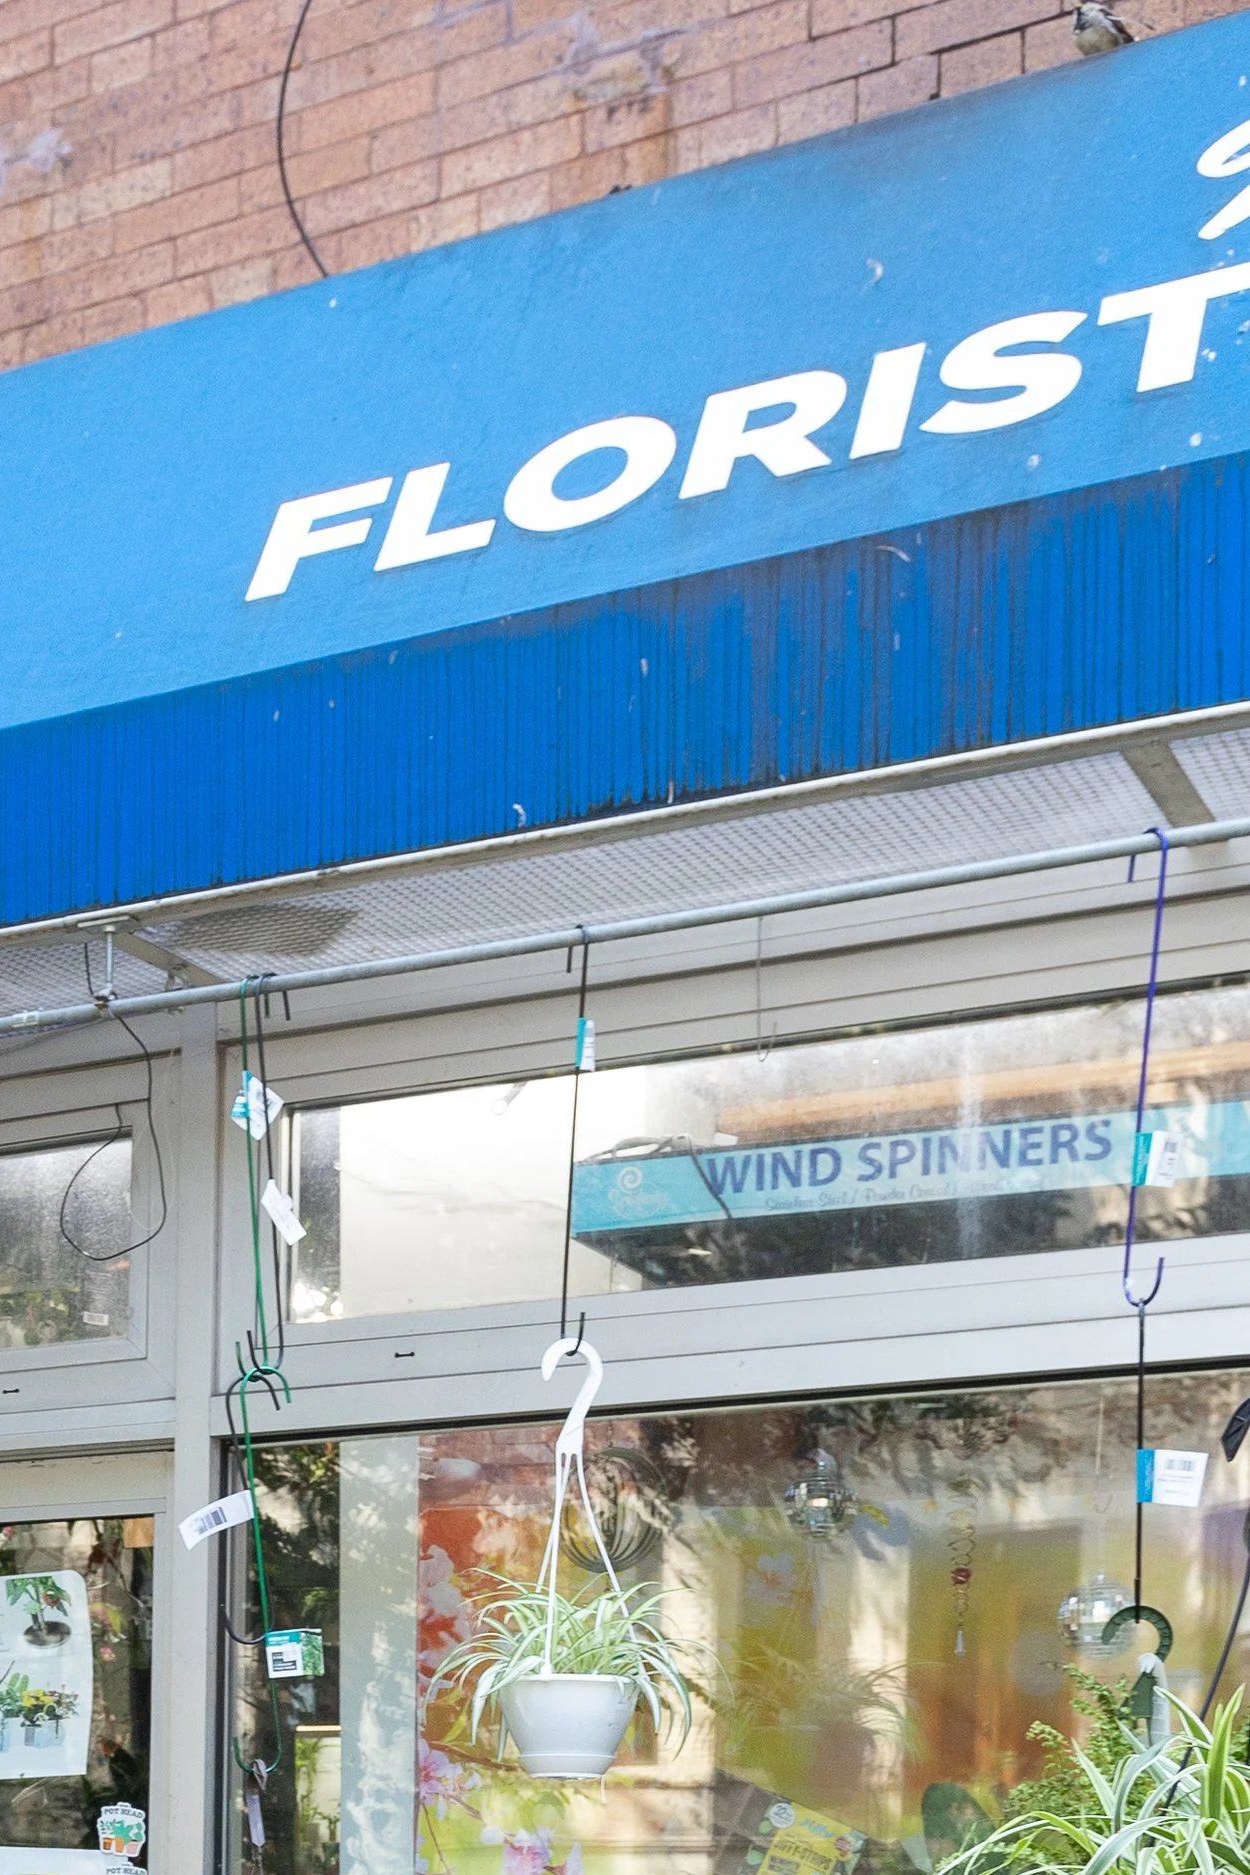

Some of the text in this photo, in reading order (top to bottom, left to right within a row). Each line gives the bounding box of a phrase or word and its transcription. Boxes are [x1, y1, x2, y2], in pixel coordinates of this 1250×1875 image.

[244, 262, 1250, 602] FLORIST
[707, 1119, 1112, 1195] WIND SPINNERS
